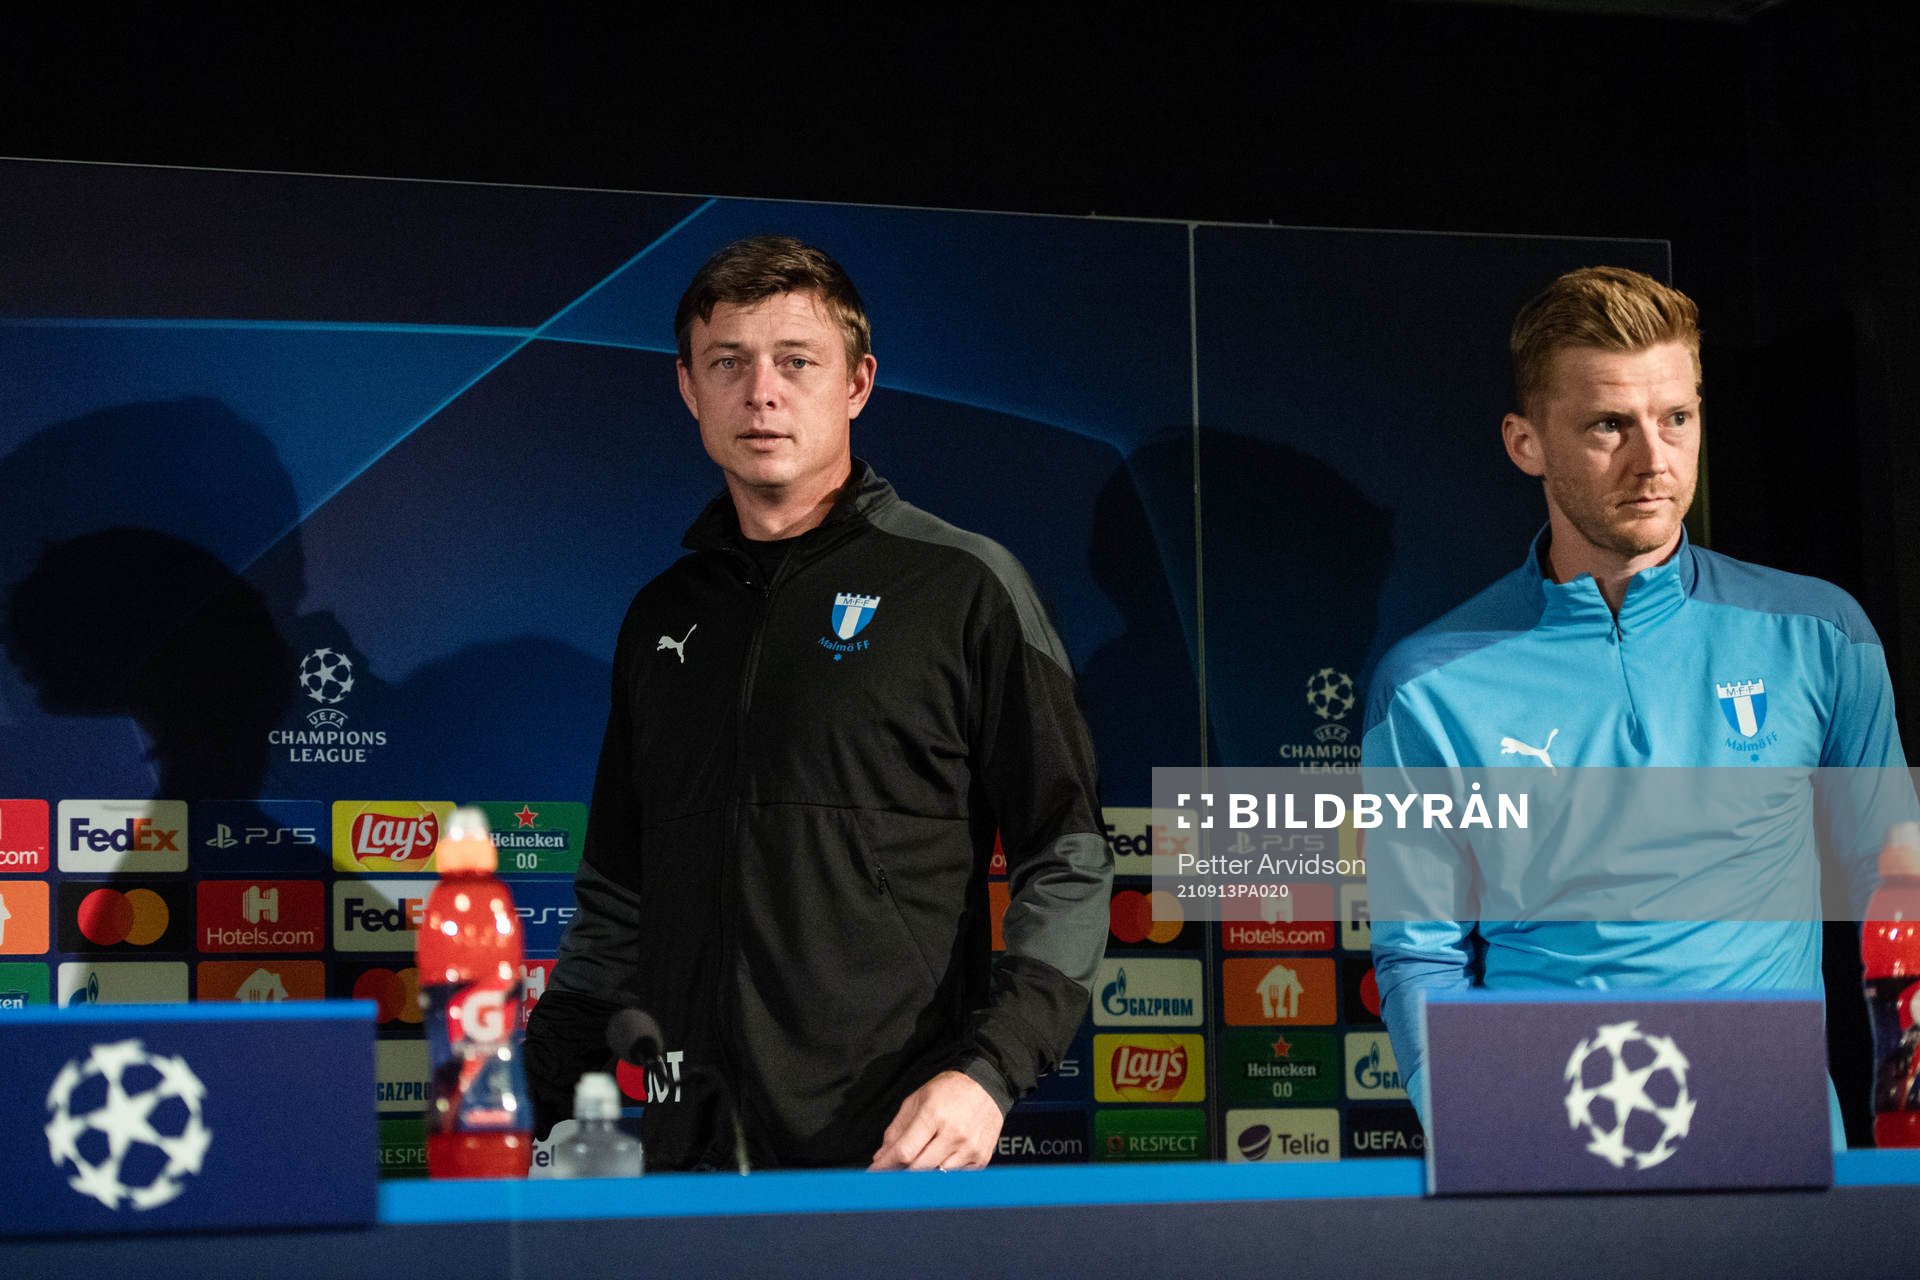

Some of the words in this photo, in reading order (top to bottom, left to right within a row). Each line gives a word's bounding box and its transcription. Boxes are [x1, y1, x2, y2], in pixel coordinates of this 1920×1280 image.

[308, 711, 346, 726] UEFA
[268, 730, 387, 746] CHAMPIONS
[1315, 727, 1348, 741] UEFA
[290, 748, 367, 763] LEAGUE
[1280, 744, 1361, 758] CHAMPIO
[1300, 761, 1361, 775] LEAGU
[70, 818, 180, 853] FedEx
[245, 828, 316, 845] PS5
[356, 814, 434, 861] Lay's
[490, 832, 564, 848] Heineken
[1262, 834, 1325, 851] PS5
[343, 898, 425, 932] FedE
[206, 927, 314, 945] Hotels.com
[1229, 927, 1326, 945] Hotels.com
[1129, 998, 1194, 1016] GAZPROM
[1115, 1046, 1185, 1091] Lay's
[1247, 1063, 1317, 1077] Heineken
[376, 1081, 431, 1101] GAZPRO
[997, 1136, 1083, 1156] EFA.com
[1129, 1135, 1198, 1151] RESPECT
[1277, 1133, 1330, 1155] Telia
[1353, 1131, 1429, 1150] UEFA.c
[375, 1147, 427, 1165] RESPE
